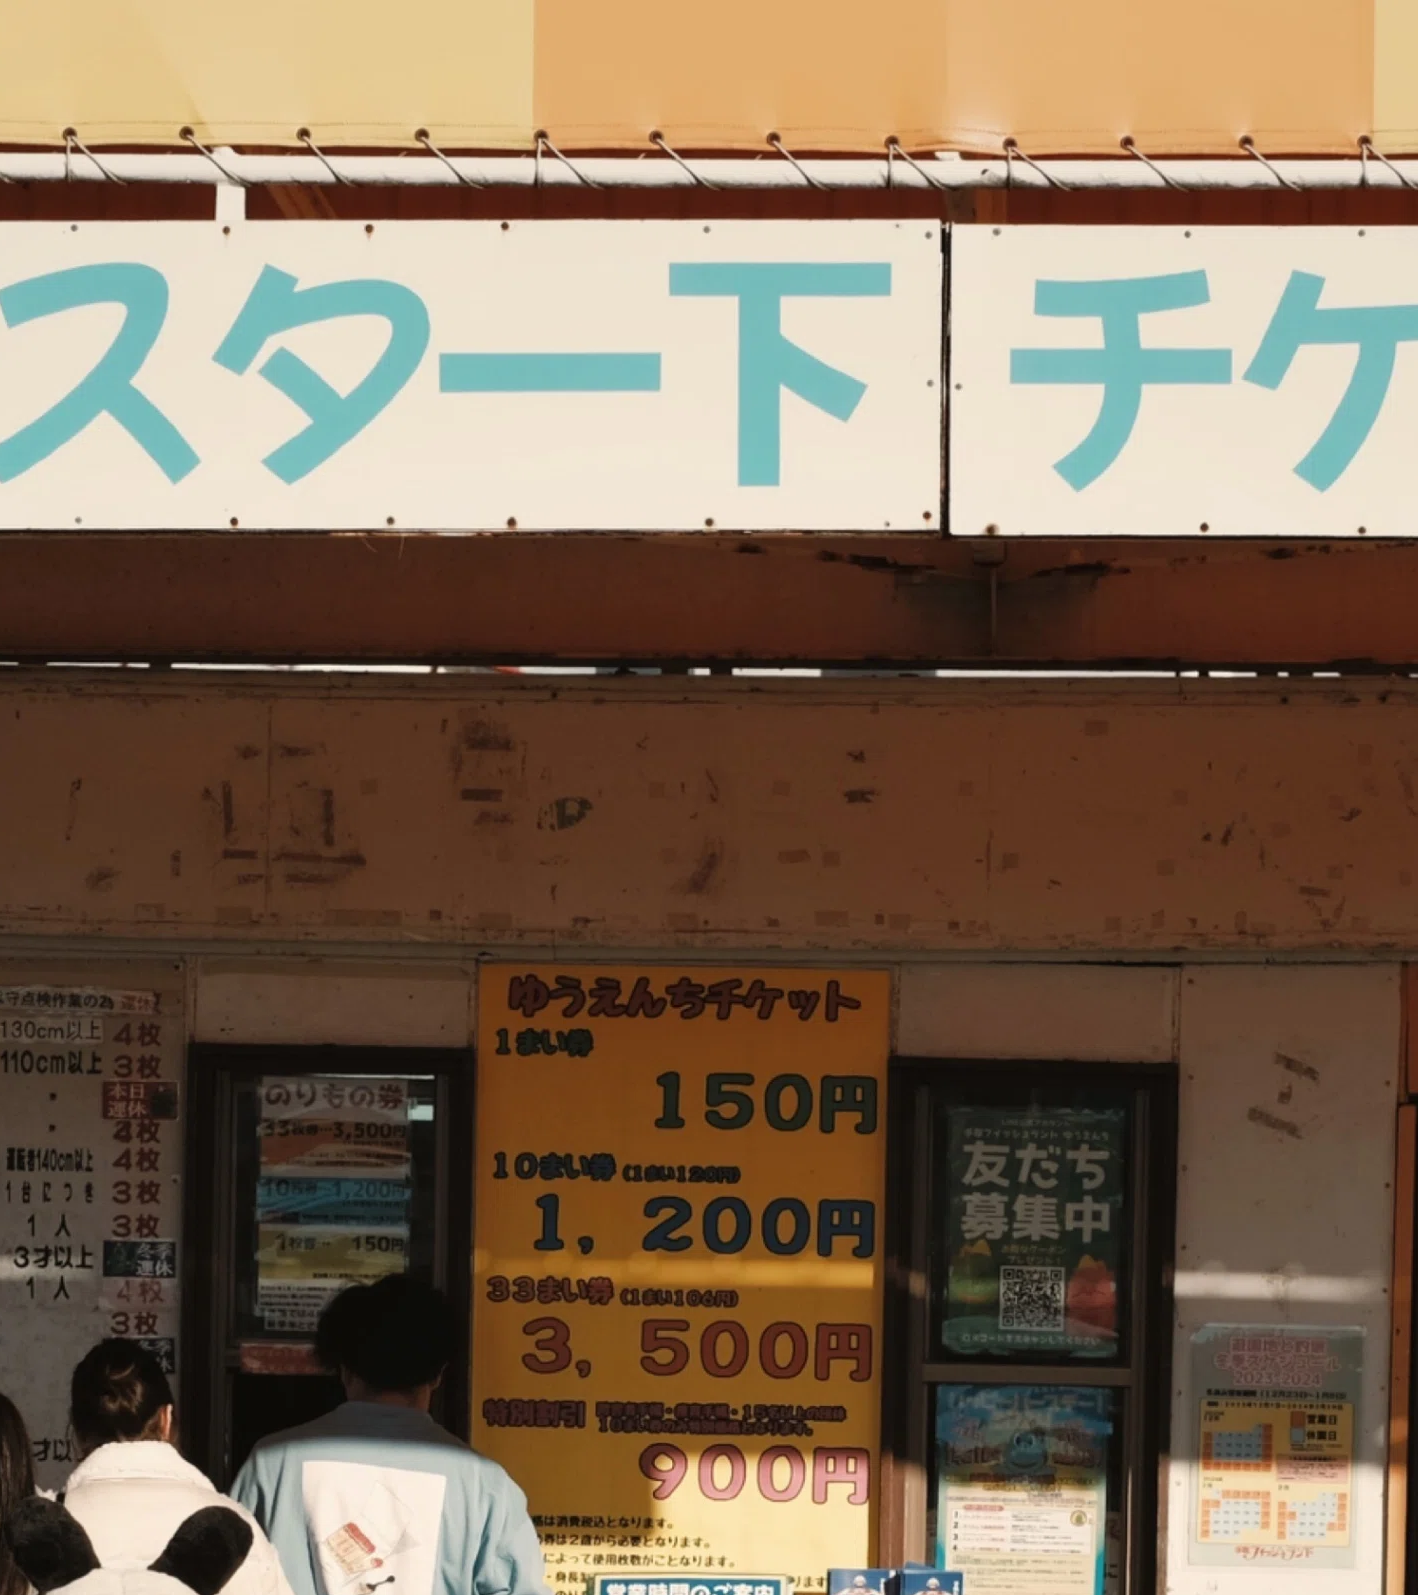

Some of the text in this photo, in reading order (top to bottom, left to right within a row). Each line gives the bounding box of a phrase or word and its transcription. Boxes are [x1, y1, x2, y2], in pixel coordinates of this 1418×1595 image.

[508, 974, 862, 1022] ゆうえんちチケット
[0, 1020, 102, 1041] 130cm以上
[112, 1022, 162, 1047] 4枚
[495, 1029, 594, 1057] 1まい券
[0, 1050, 102, 1075] 110cm以上
[113, 1055, 162, 1080] 3枚
[265, 1082, 403, 1110] のりもの券
[654, 1071, 879, 1135] 150円
[112, 1147, 161, 1173] 4枚
[493, 1152, 617, 1182] 10まい券
[961, 1140, 1112, 1190] 友だち
[112, 1180, 161, 1205] 3枚
[111, 1214, 160, 1238] 3枚
[533, 1193, 876, 1258] 1,200円
[960, 1192, 1112, 1244] 募集中
[13, 1245, 94, 1270] 3才以上
[117, 1280, 164, 1305] 4枚
[486, 1276, 614, 1305] 33まい券
[111, 1311, 159, 1335] 3枚
[522, 1316, 874, 1382] 3,500円
[482, 1398, 587, 1428] 特別割引
[639, 1442, 870, 1505] 900円
